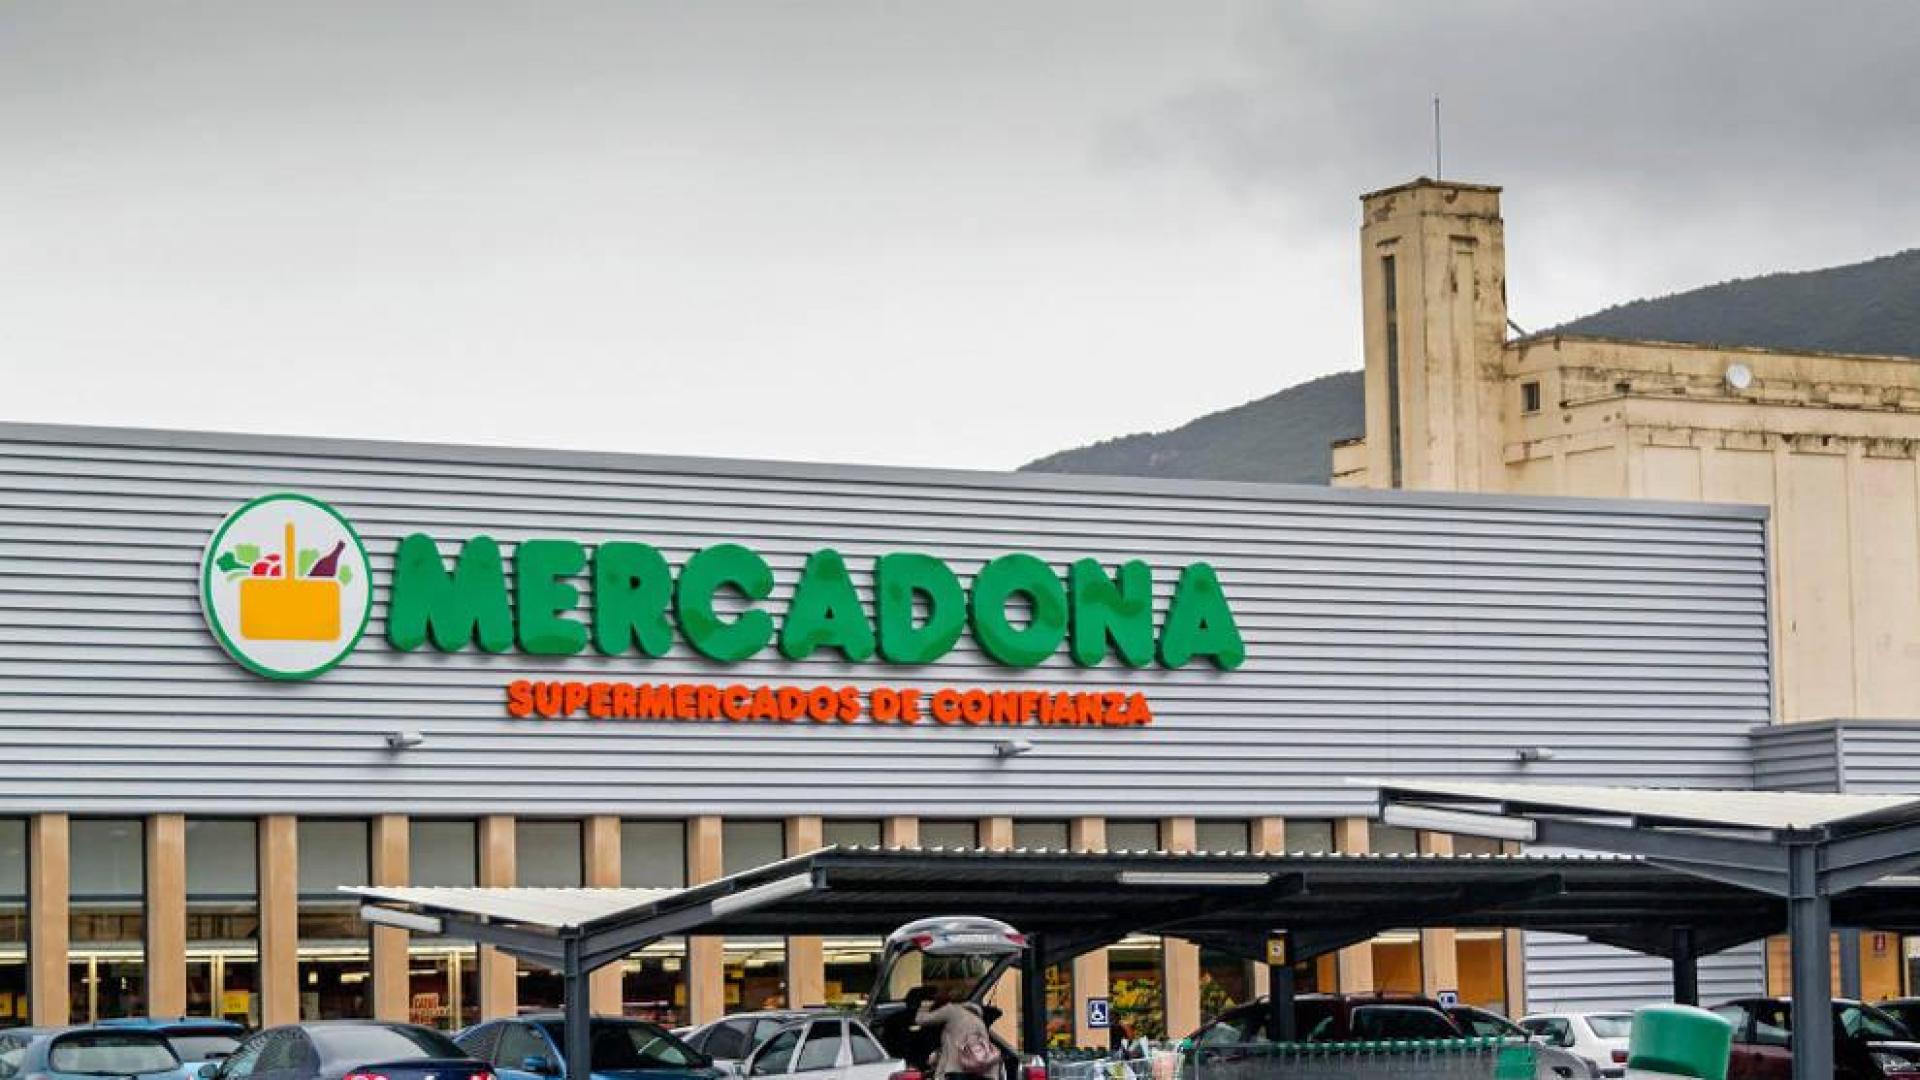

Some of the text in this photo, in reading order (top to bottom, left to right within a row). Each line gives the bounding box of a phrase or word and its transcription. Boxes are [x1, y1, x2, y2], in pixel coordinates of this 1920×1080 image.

[387, 532, 1247, 671] MERCADONA
[506, 680, 1152, 726] SUPERMERCADOS DE CONFIANZA
